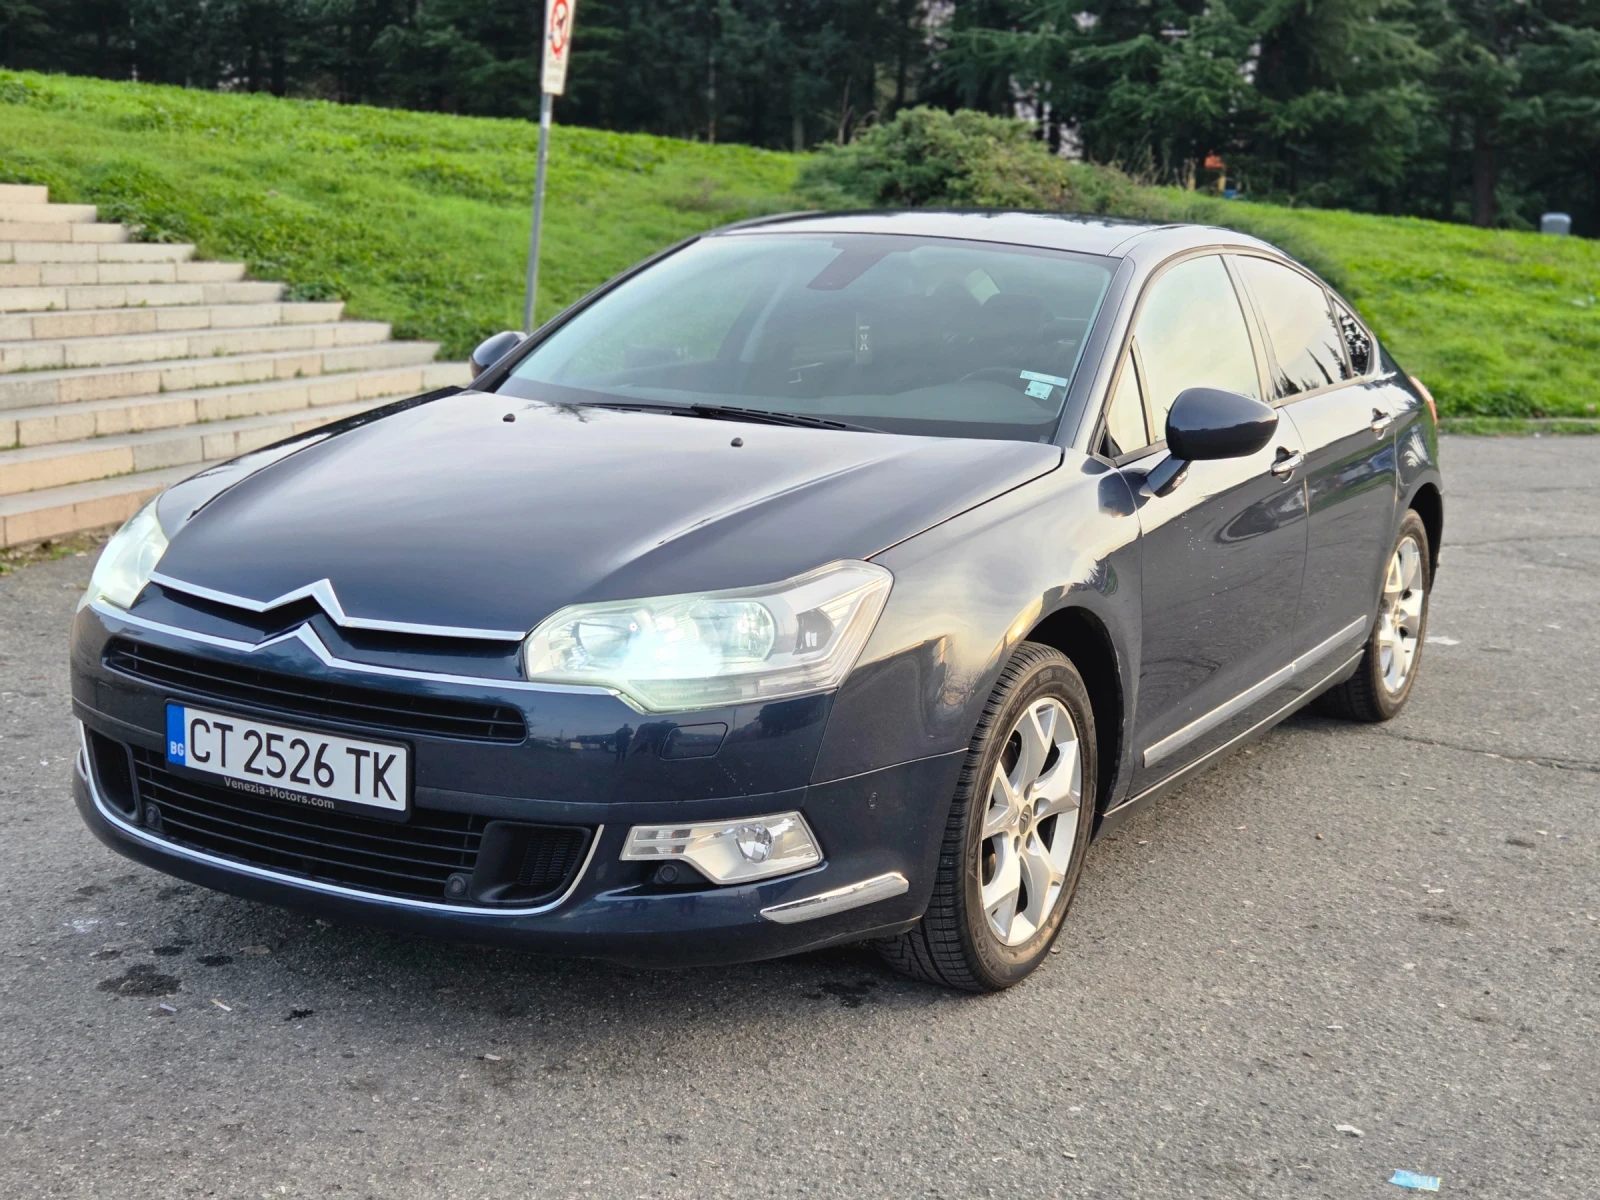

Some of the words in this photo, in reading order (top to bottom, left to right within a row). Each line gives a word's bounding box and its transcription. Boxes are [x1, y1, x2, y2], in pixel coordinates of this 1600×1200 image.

[170, 741, 184, 757] BG
[190, 718, 233, 768] CT
[243, 729, 335, 788] 2526
[345, 747, 398, 801] TK
[223, 776, 335, 810] Venezia-Motors.com
